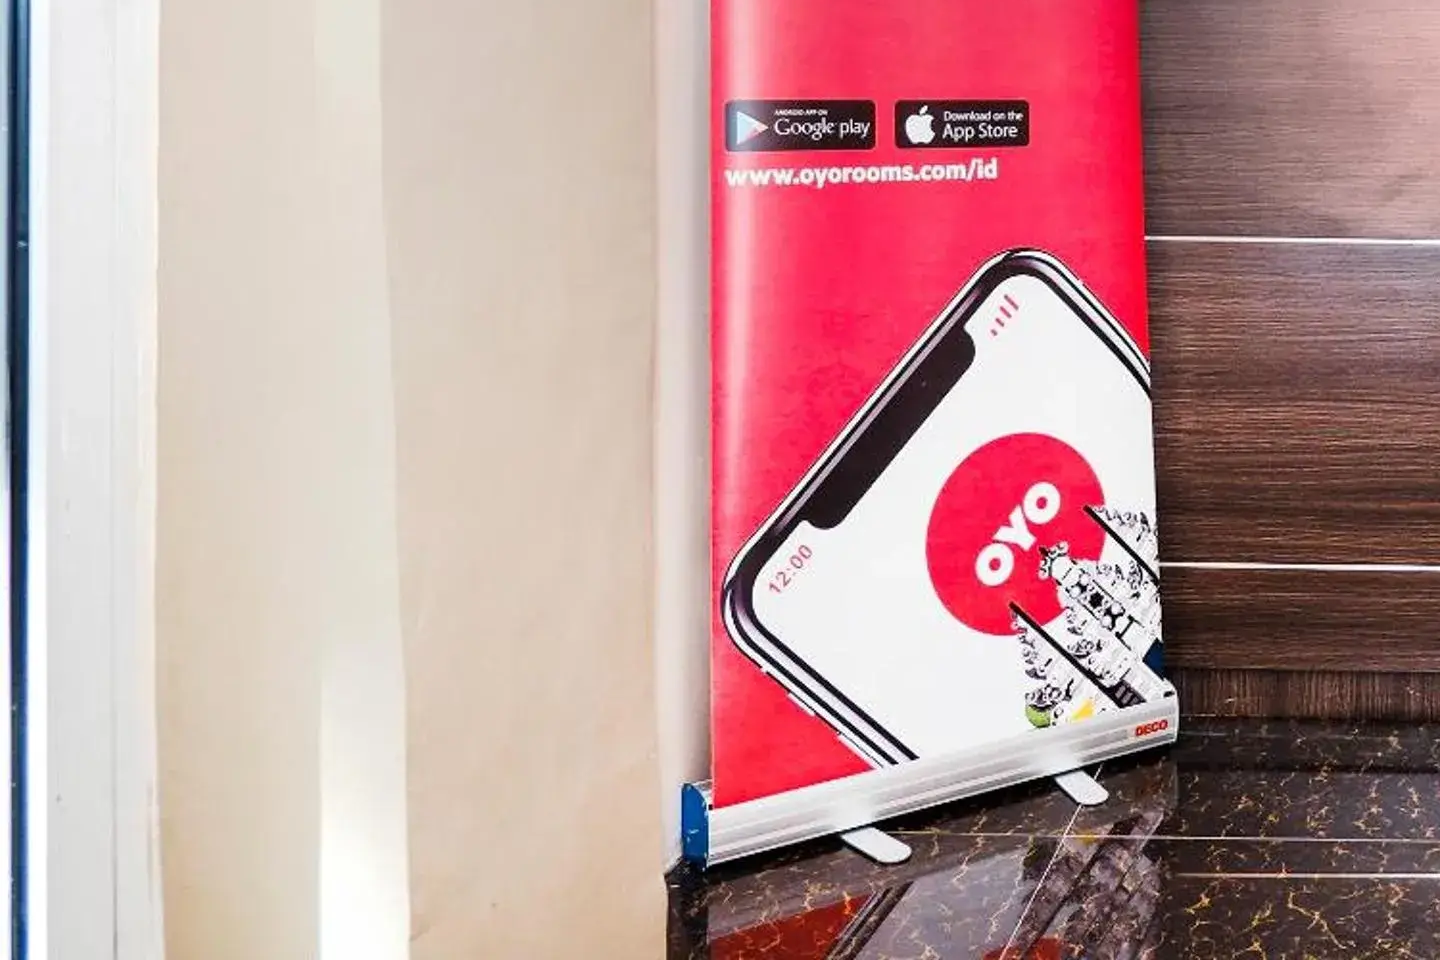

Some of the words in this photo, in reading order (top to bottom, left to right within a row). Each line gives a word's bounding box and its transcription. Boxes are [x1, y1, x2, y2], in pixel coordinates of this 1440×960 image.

[944, 111, 991, 121] Download
[1007, 111, 1023, 121] the
[775, 117, 836, 141] Google
[840, 118, 870, 139] play
[942, 123, 975, 142] App
[978, 122, 1018, 139] Store
[724, 157, 998, 189] www.oyorooms.com/id
[976, 481, 1061, 586] OYO
[769, 545, 812, 593] 12:00
[1134, 719, 1168, 737] DECO
